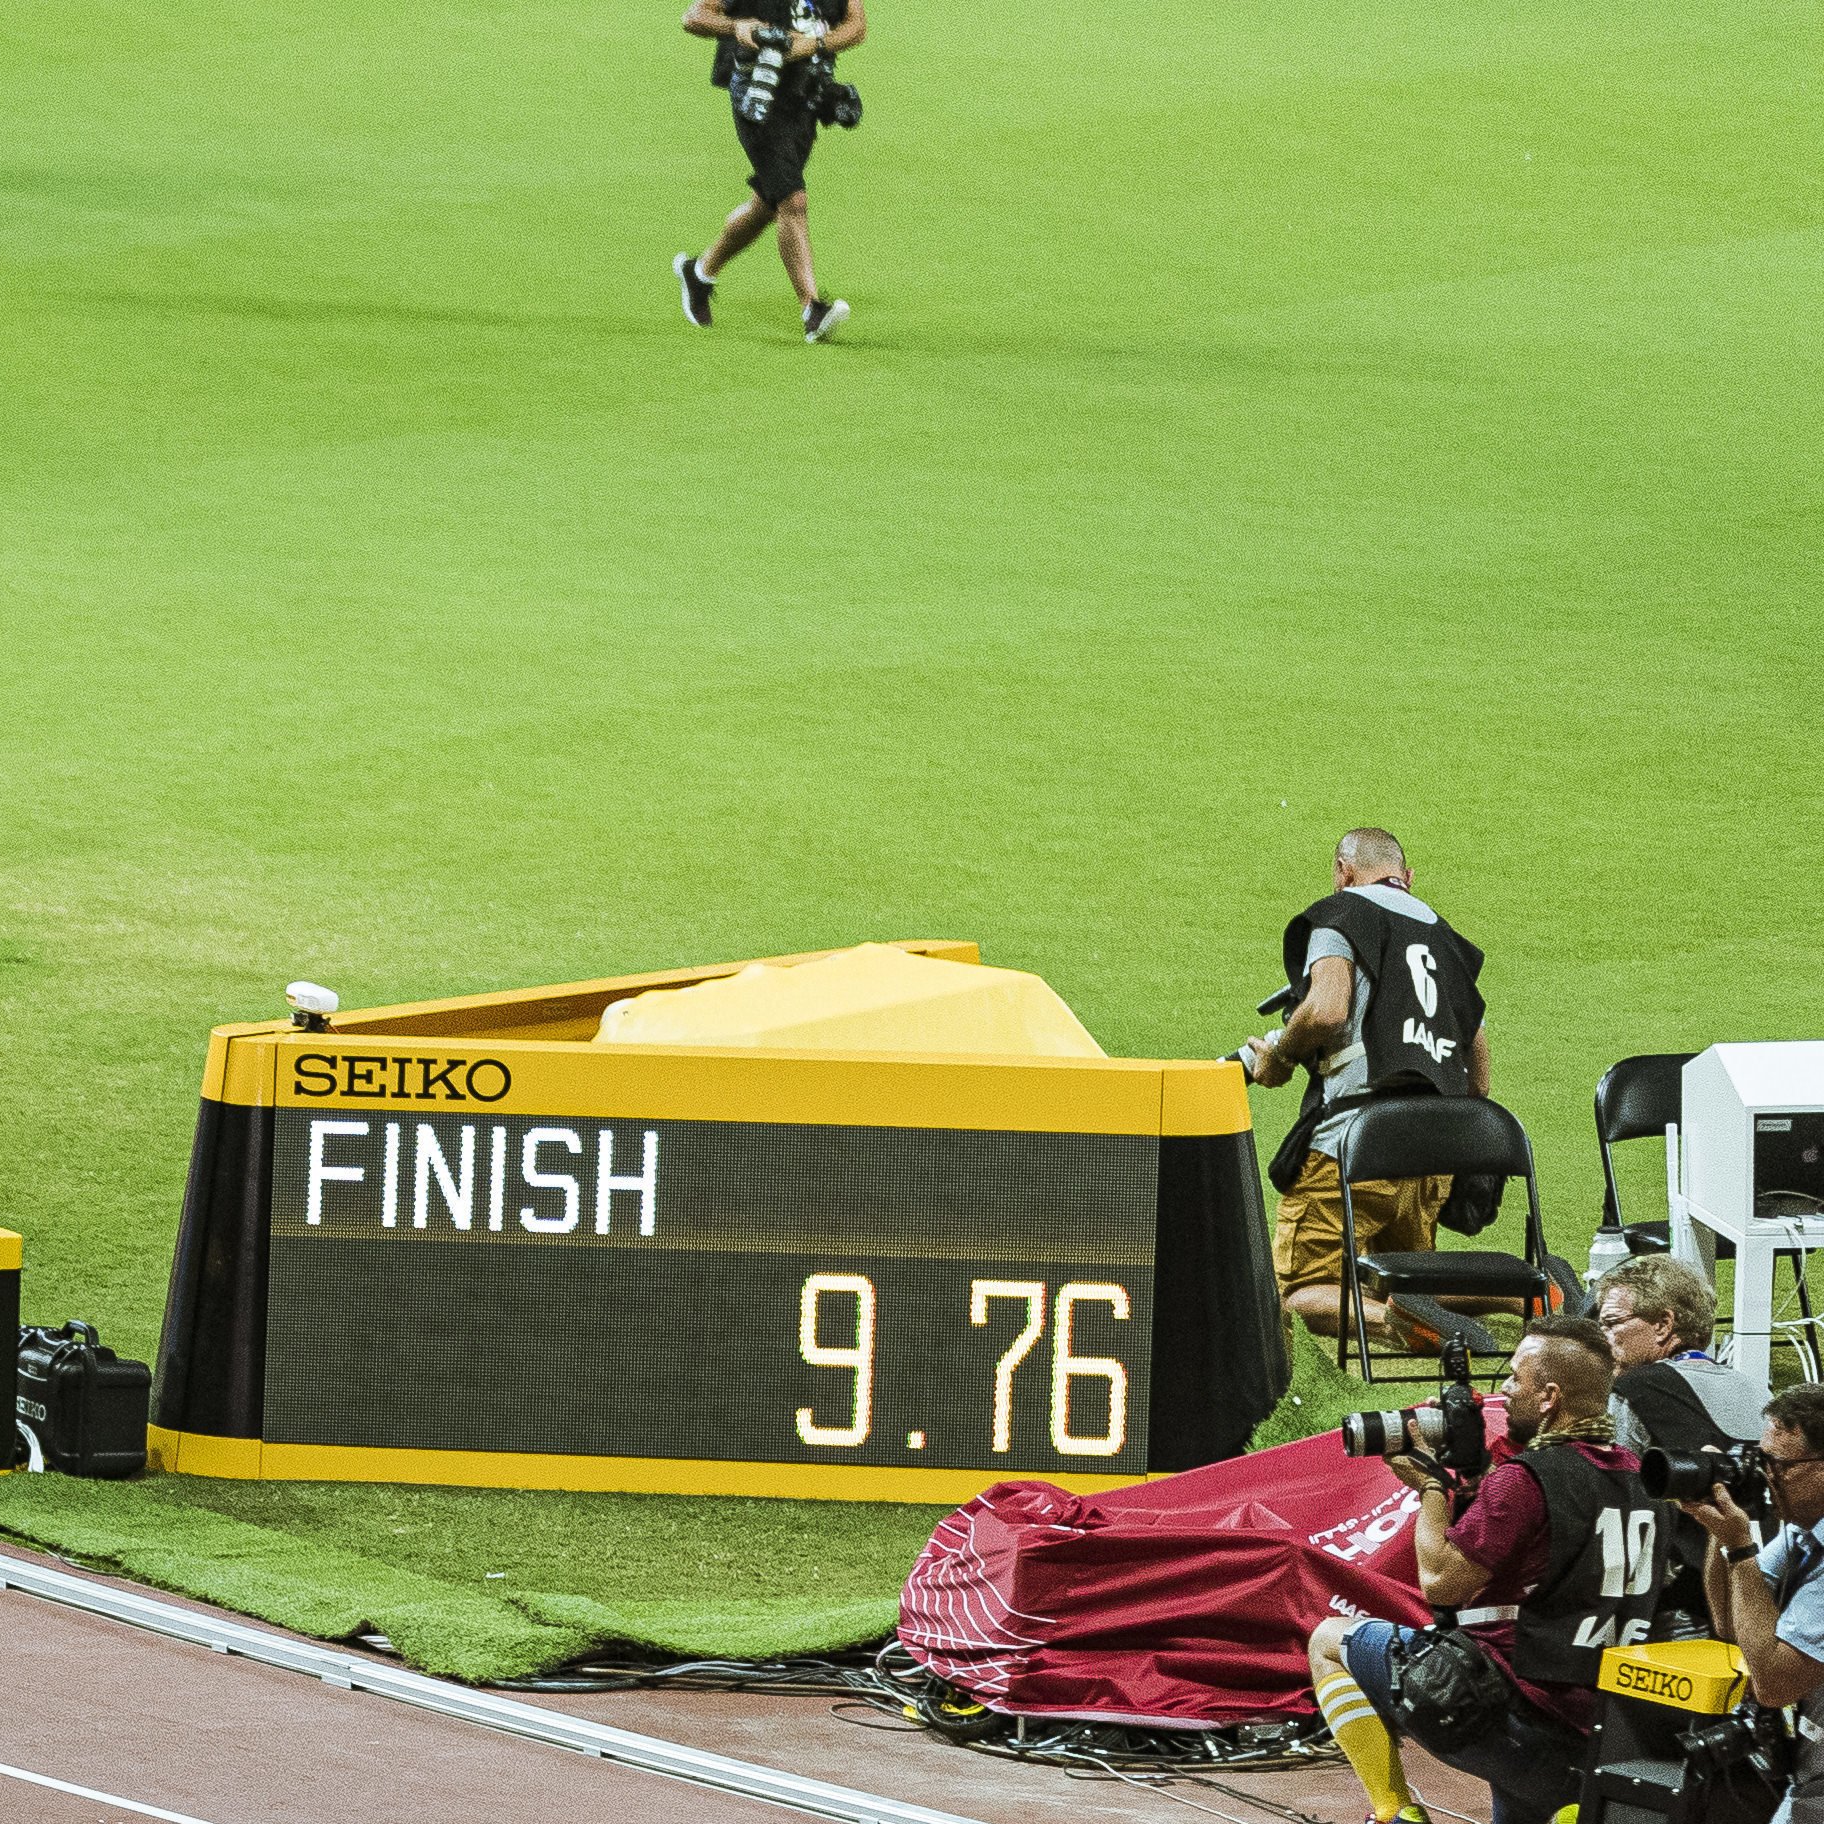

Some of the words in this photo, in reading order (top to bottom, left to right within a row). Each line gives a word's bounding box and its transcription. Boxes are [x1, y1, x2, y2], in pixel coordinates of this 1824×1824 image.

[1405, 943, 1438, 1019] 6
[294, 1053, 512, 1103] SEIKO
[307, 1120, 659, 1237] FINISH
[1595, 1507, 1656, 1598] 10
[1615, 1662, 1694, 1702] SEIKO
